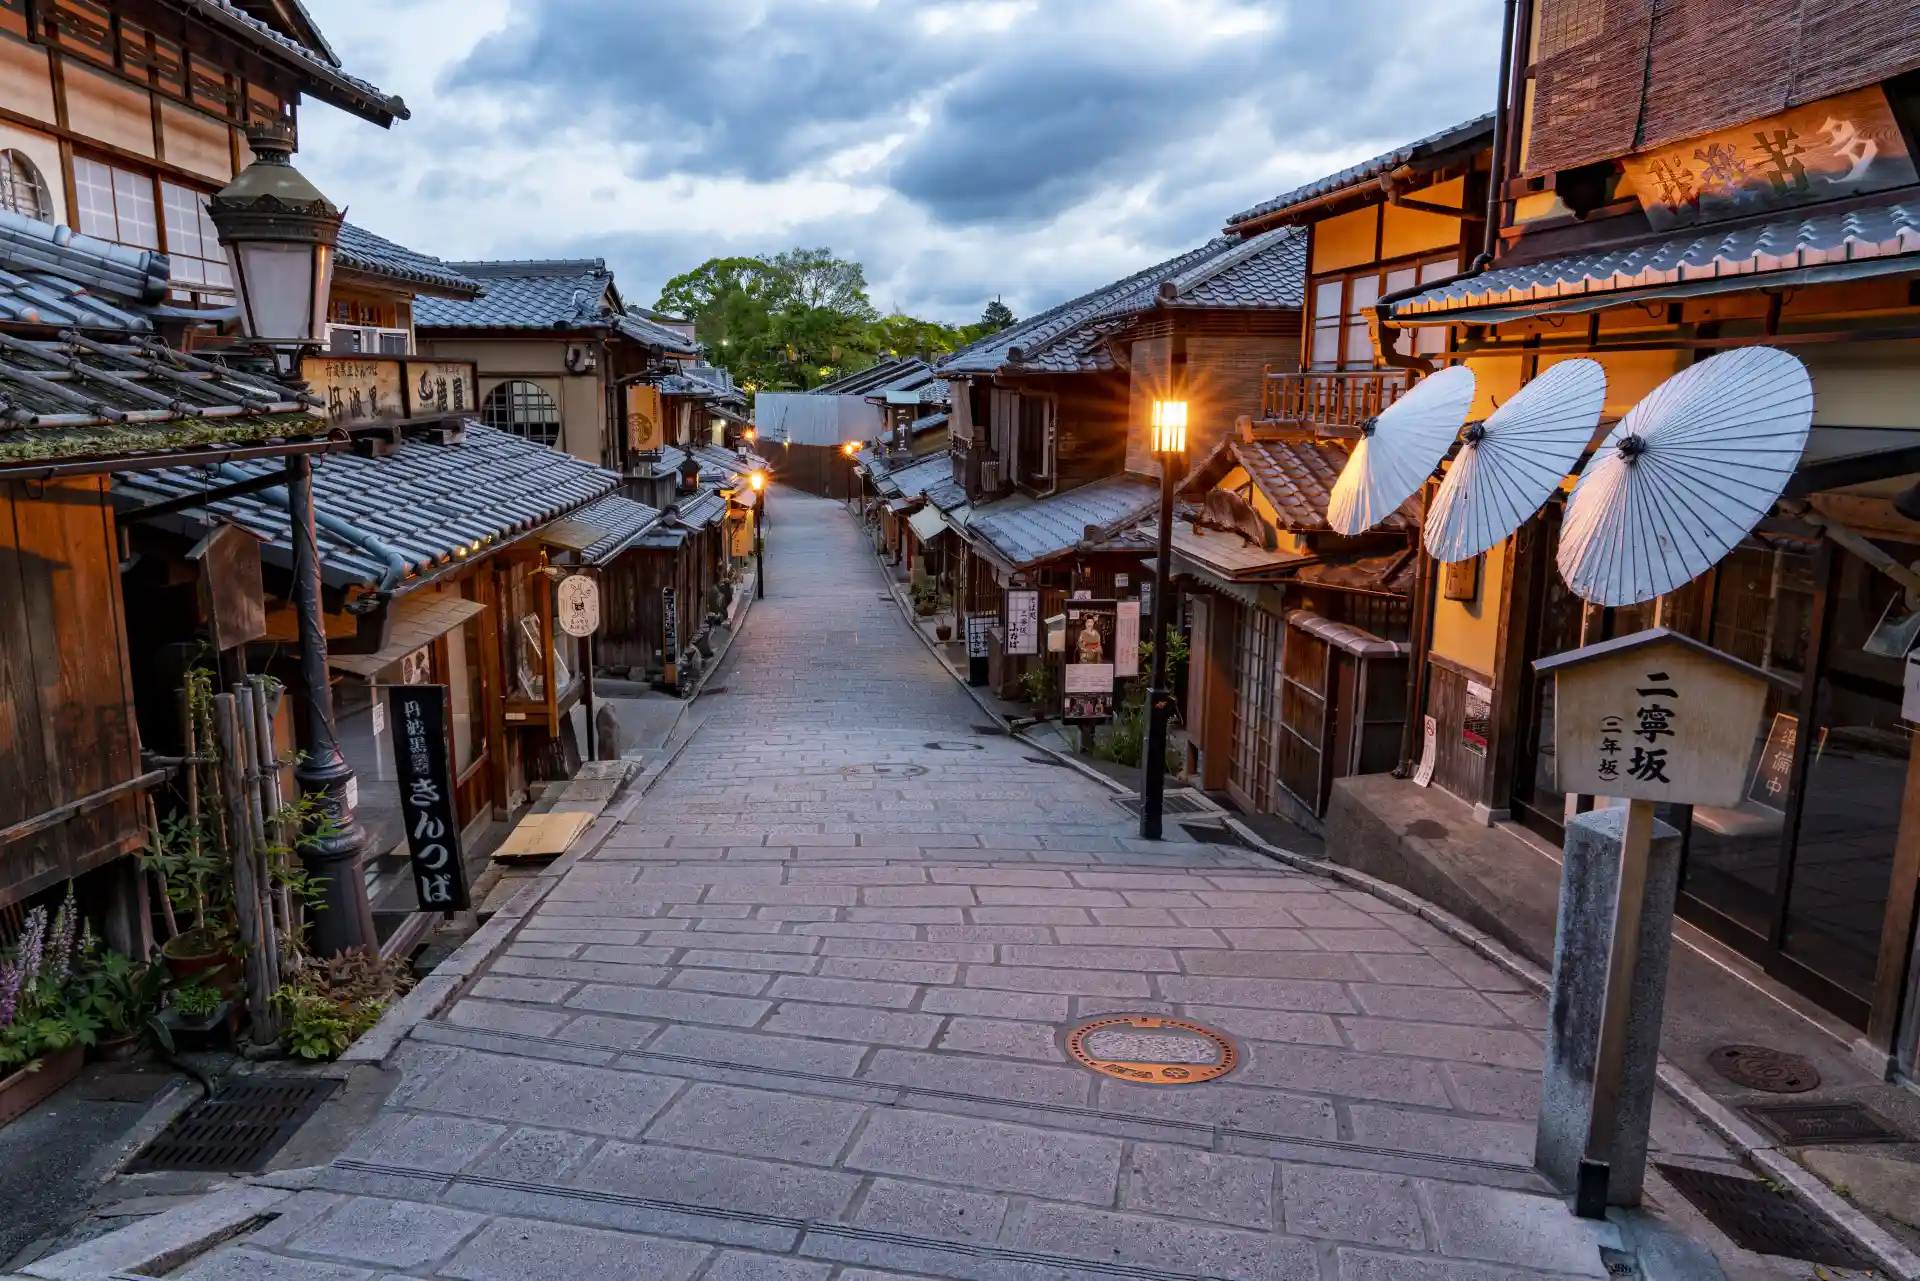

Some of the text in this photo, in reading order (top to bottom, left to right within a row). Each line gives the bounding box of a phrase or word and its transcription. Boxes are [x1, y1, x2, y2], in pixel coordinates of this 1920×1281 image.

[1009, 622, 1020, 649] ふたば
[1597, 716, 1624, 781] (二年坂)
[1626, 671, 1679, 784] 二寧坂
[1764, 727, 1797, 797] 準備中
